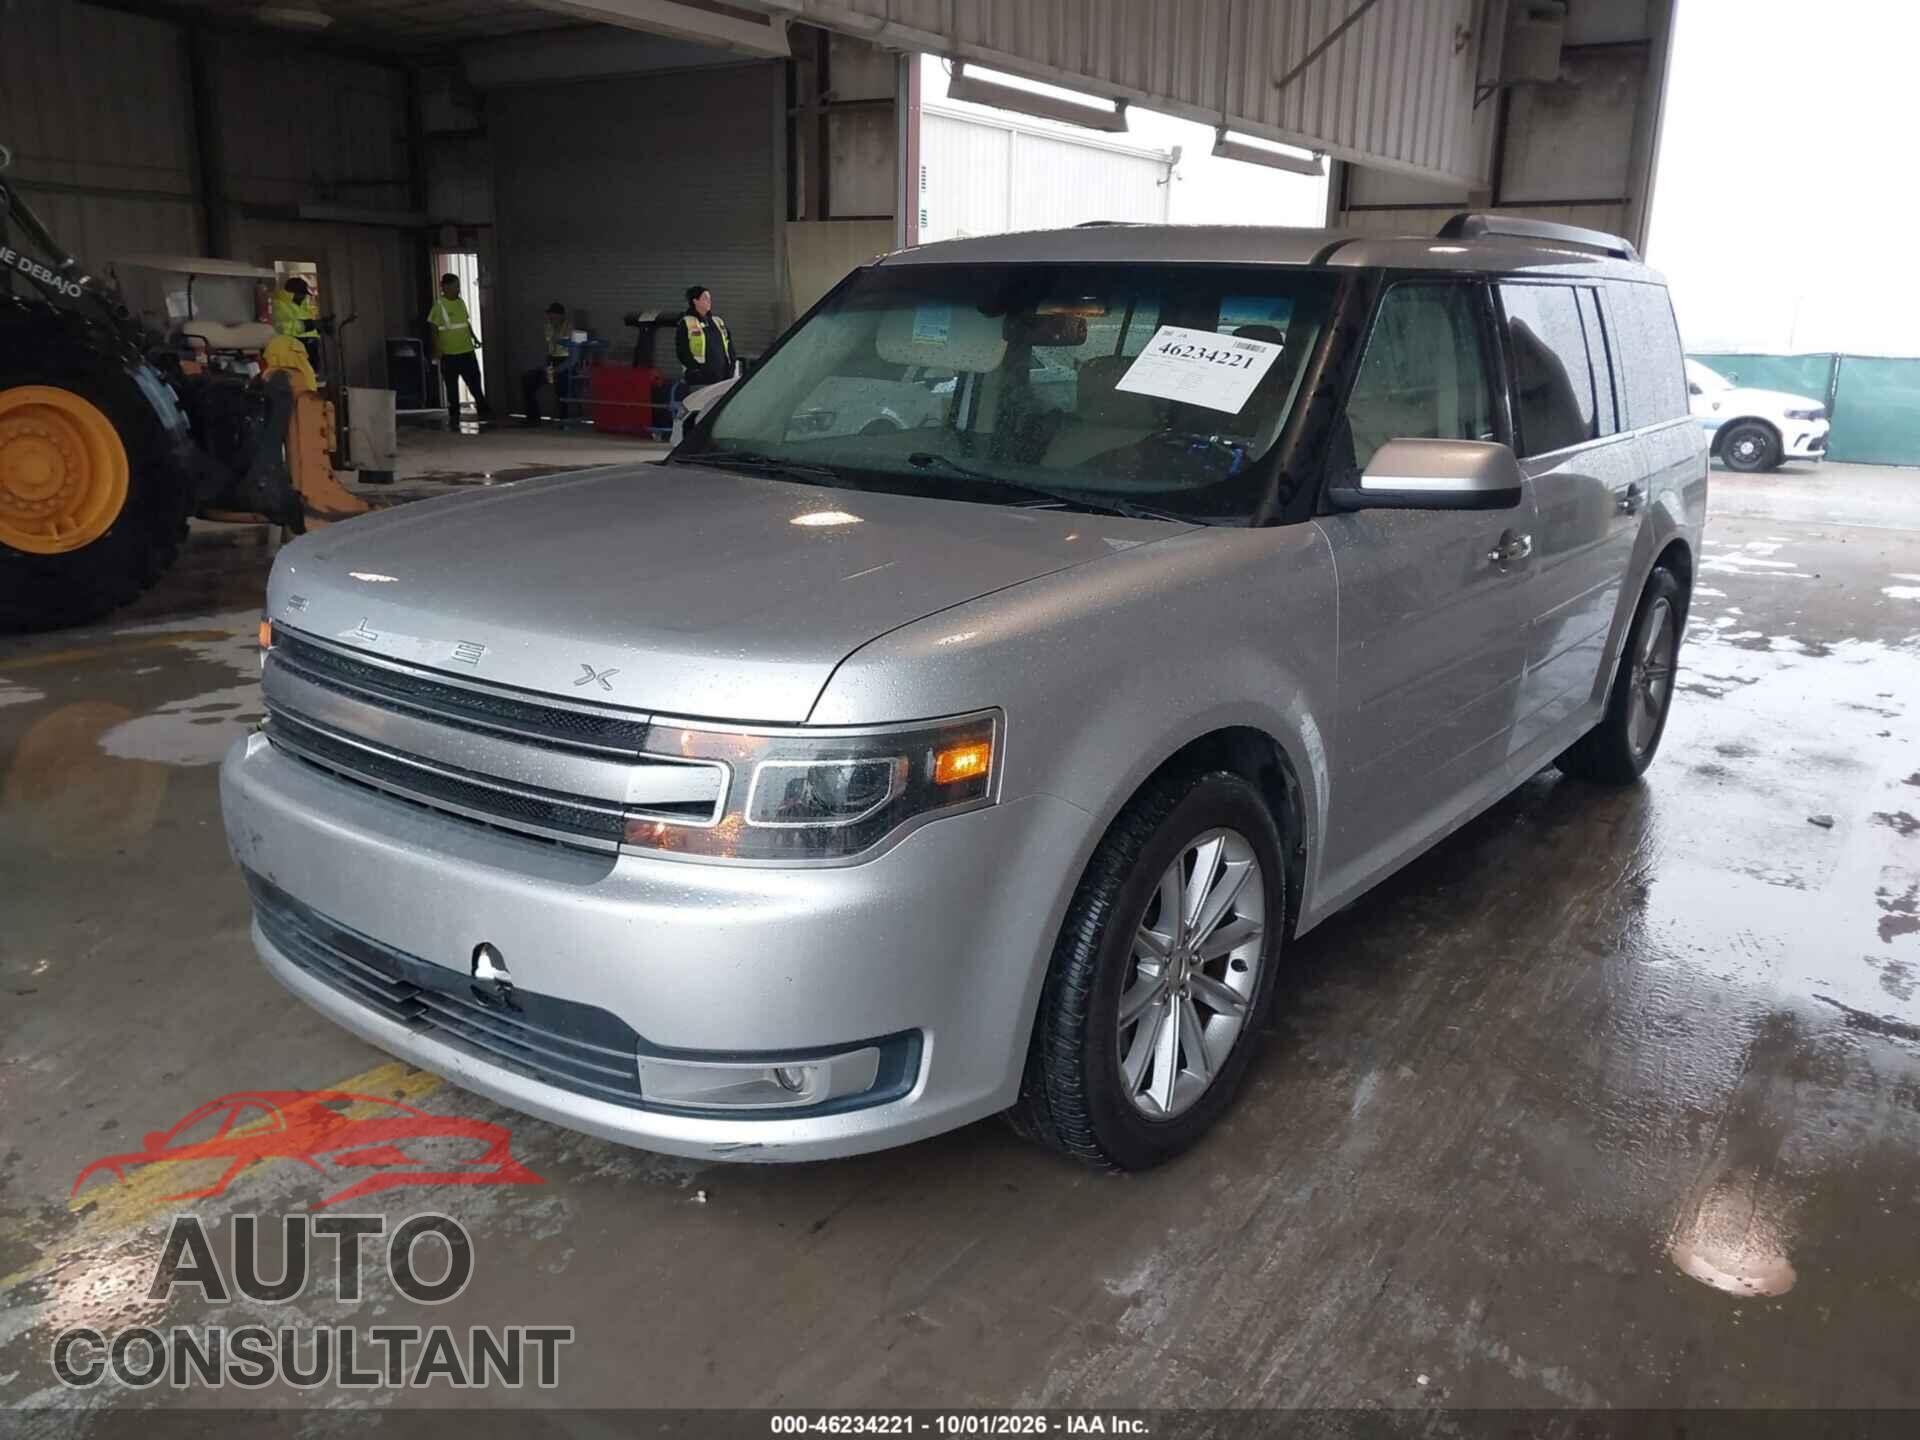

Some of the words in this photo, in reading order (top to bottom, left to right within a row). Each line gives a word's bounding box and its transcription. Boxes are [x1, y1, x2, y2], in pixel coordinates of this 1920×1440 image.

[18, 257, 81, 297] DEBAJO
[1158, 341, 1254, 370] 46234221
[285, 594, 620, 692] FLEX
